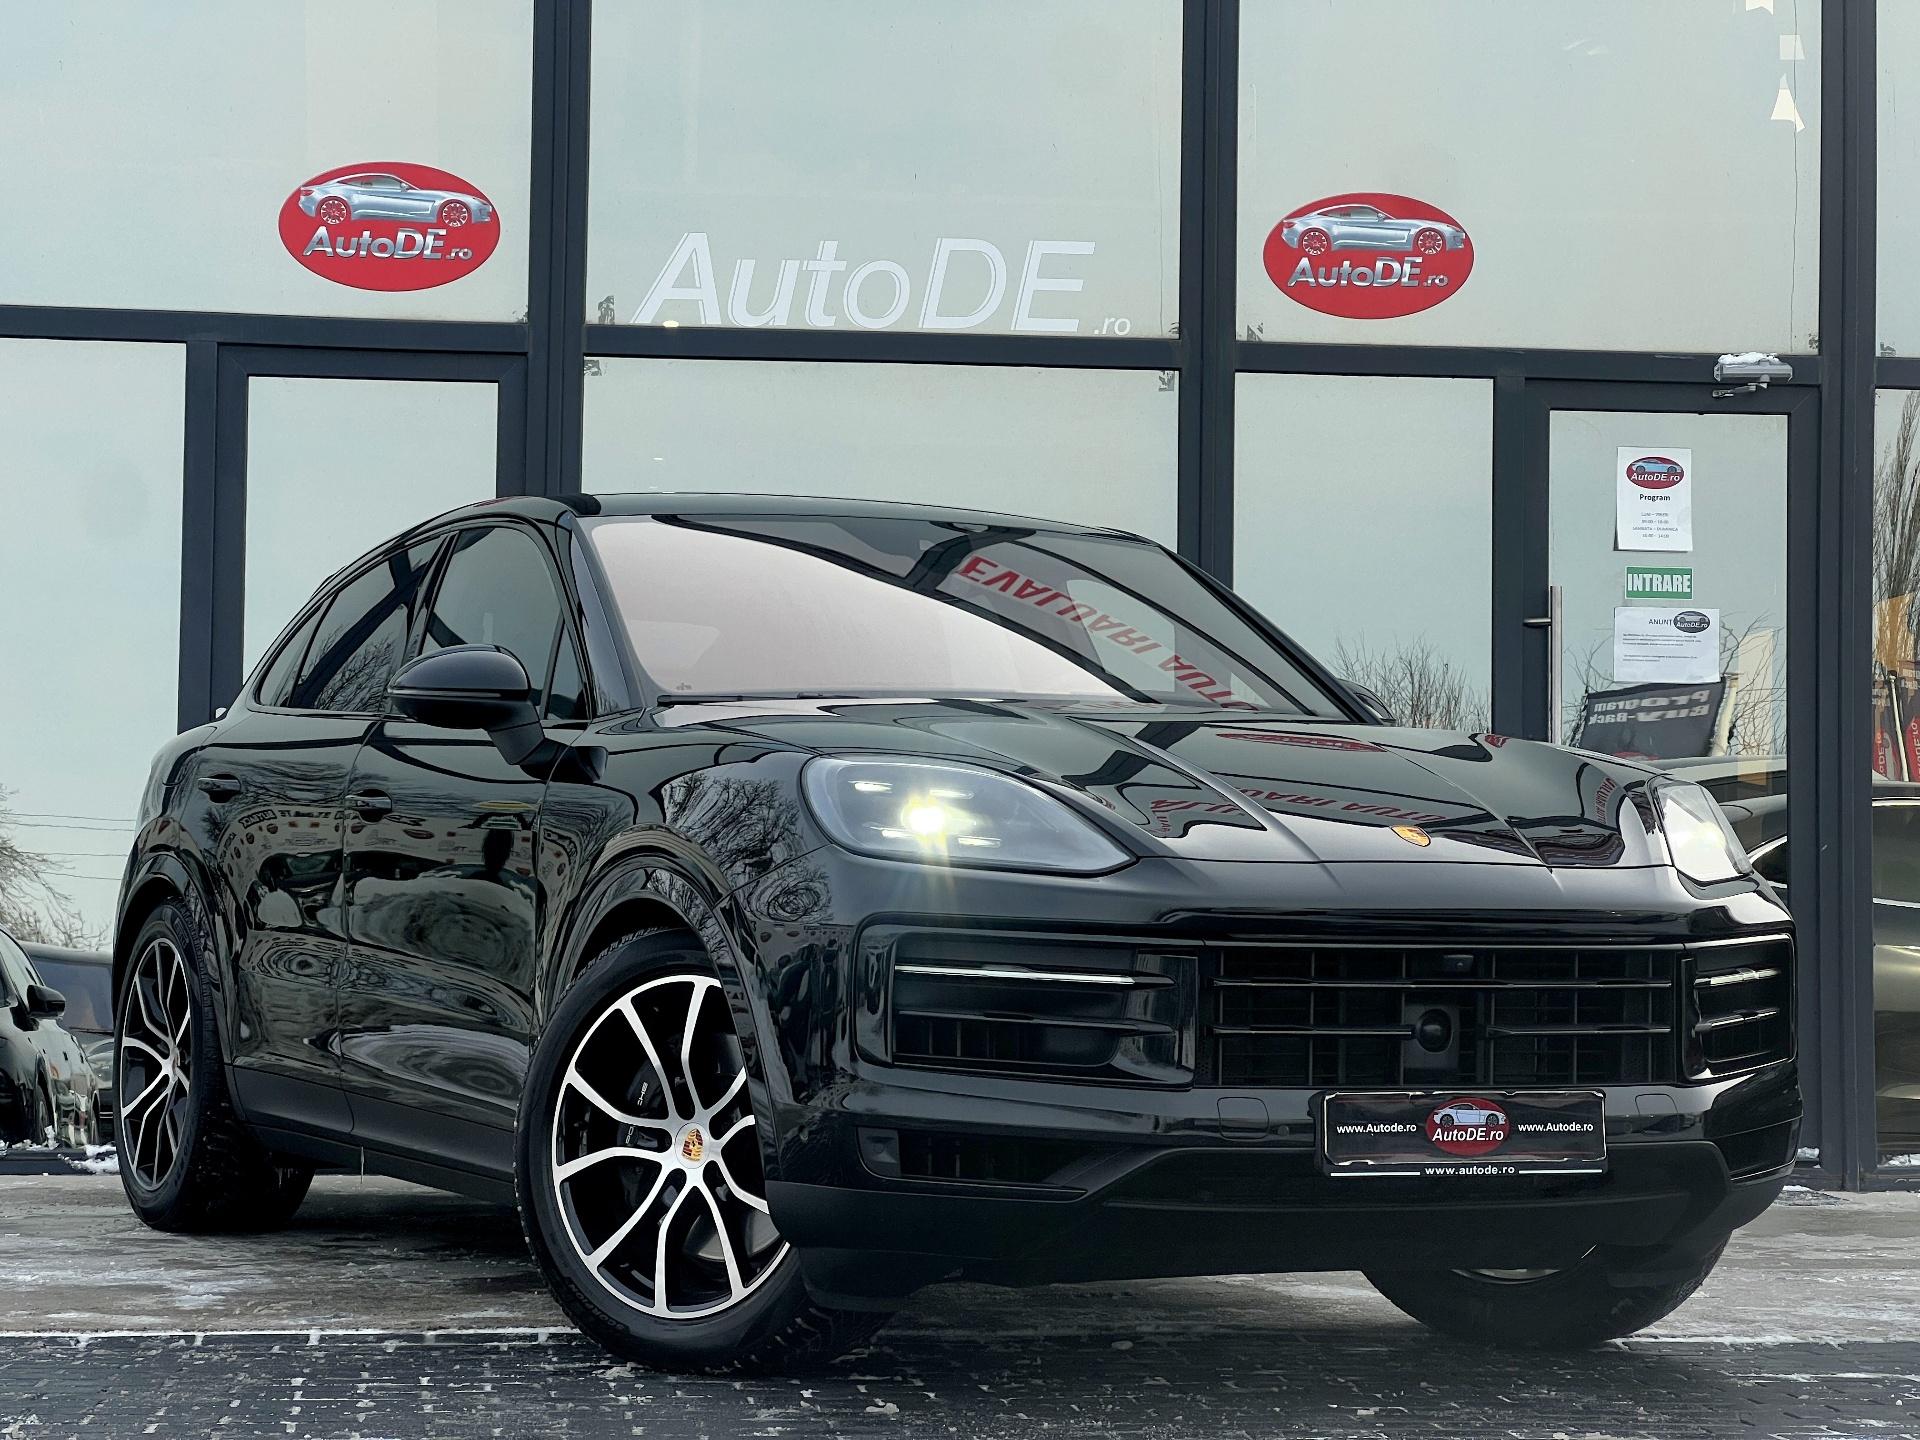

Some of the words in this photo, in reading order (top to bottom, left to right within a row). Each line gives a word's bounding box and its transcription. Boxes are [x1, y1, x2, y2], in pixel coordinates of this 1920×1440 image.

[1631, 472, 1681, 482] AutoDE.ro
[1639, 493, 1671, 502] Program
[1627, 573, 1691, 593] INTRARE
[1336, 1122, 1417, 1134] www.Autode.ro
[1431, 1127, 1504, 1142] AutoDE.ro
[1517, 1121, 1594, 1133] www.Autode.ro
[1424, 1164, 1516, 1176] www.autode.ro
